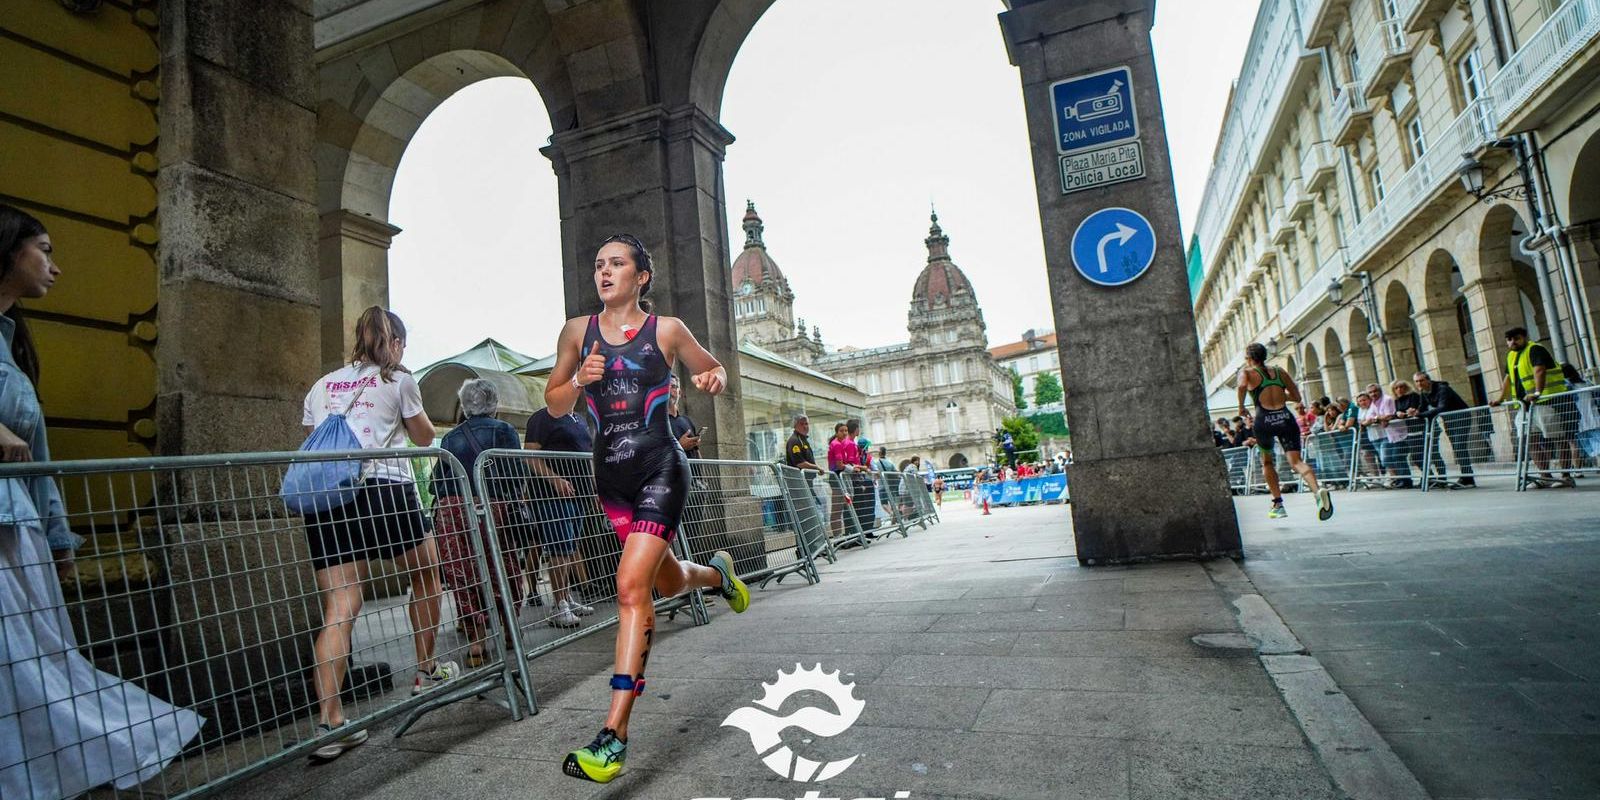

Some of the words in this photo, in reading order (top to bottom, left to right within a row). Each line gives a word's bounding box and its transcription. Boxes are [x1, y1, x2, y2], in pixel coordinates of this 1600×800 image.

[1063, 129, 1087, 143] ZONA
[1090, 120, 1131, 137] VIGILADA
[1065, 158, 1089, 172] Plaza
[1118, 146, 1137, 161] Pita
[1108, 161, 1140, 179] Local
[601, 377, 639, 397] CASALS
[605, 449, 635, 464] sailfish
